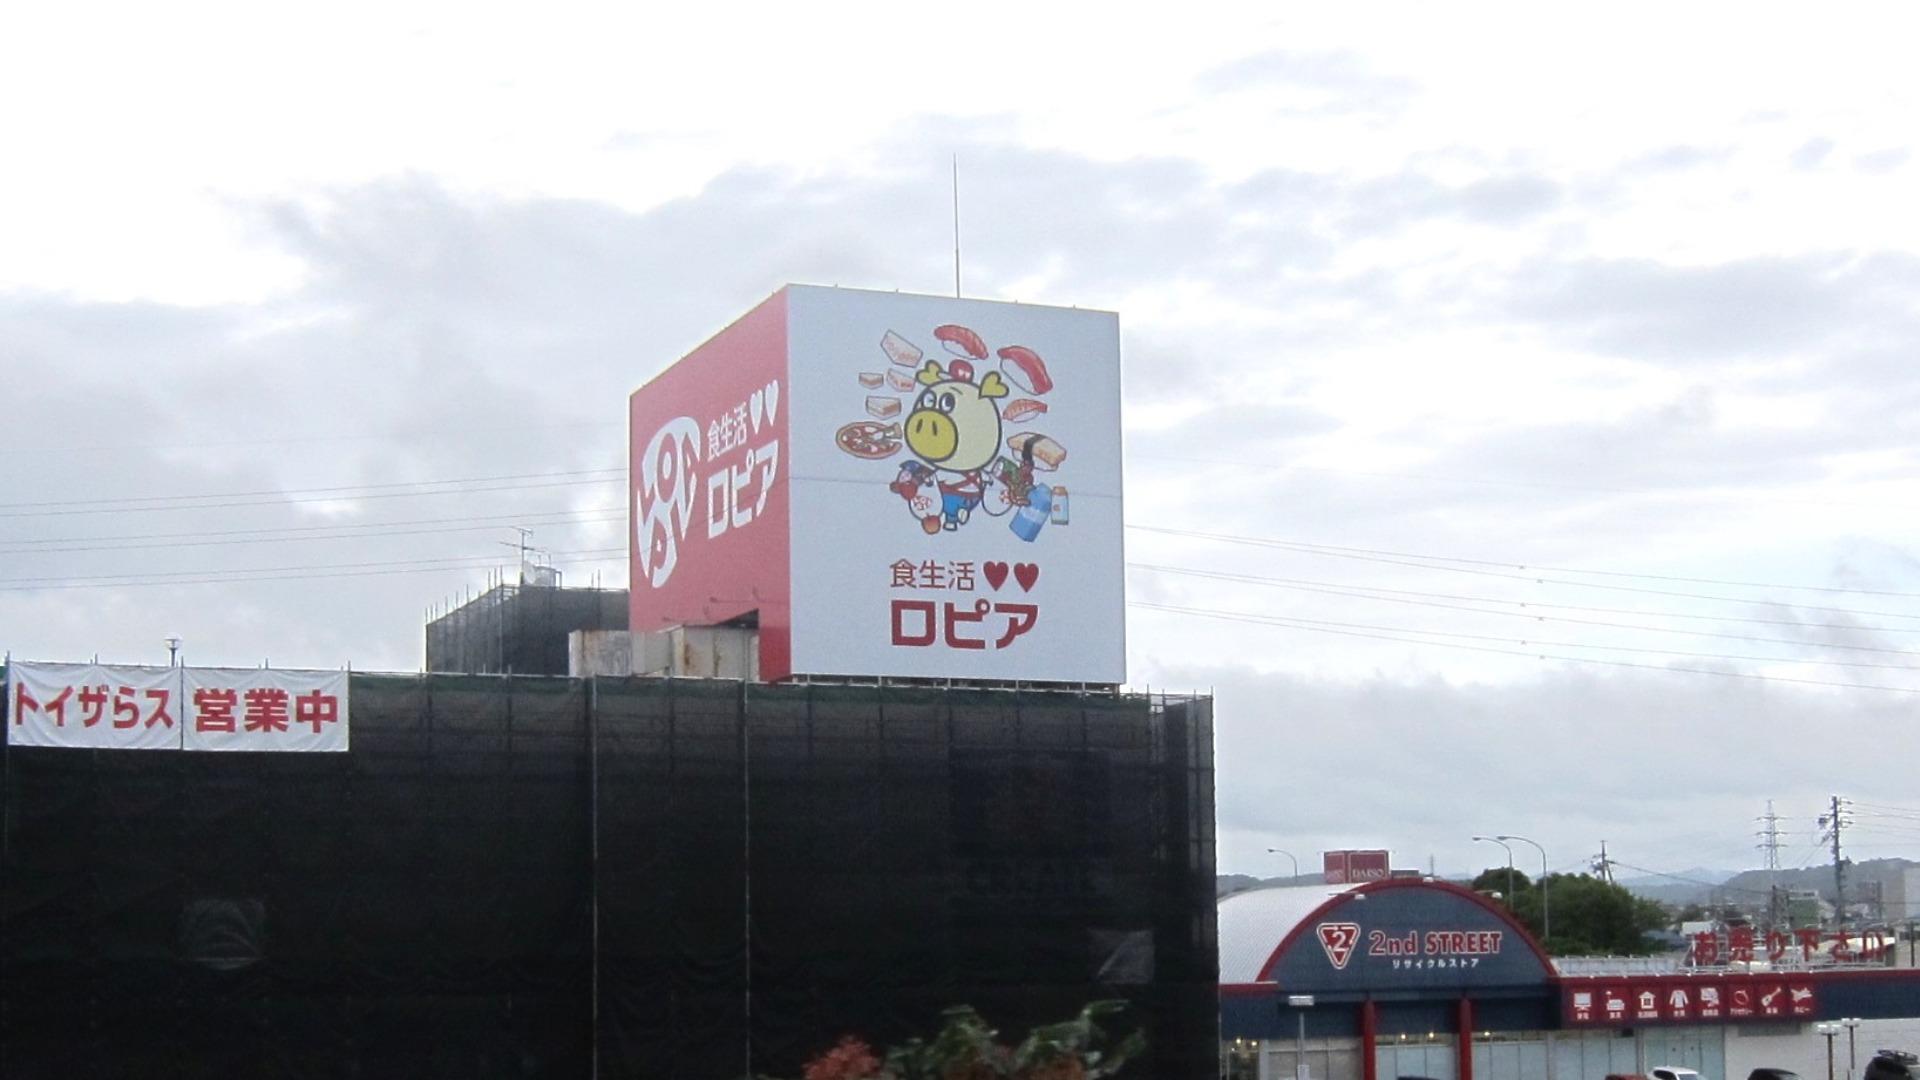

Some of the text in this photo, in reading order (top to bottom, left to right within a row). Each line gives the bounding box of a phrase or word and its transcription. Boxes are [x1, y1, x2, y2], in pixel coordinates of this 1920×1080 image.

[708, 402, 747, 462] 食生活
[708, 440, 779, 539] ロピア
[889, 558, 975, 591] 食生活
[891, 598, 1038, 649] ロピア
[15, 682, 339, 734] トイザらス 営業中
[1369, 930, 1502, 956] 2nd STREET
[1392, 959, 1479, 970] リサイクルストア
